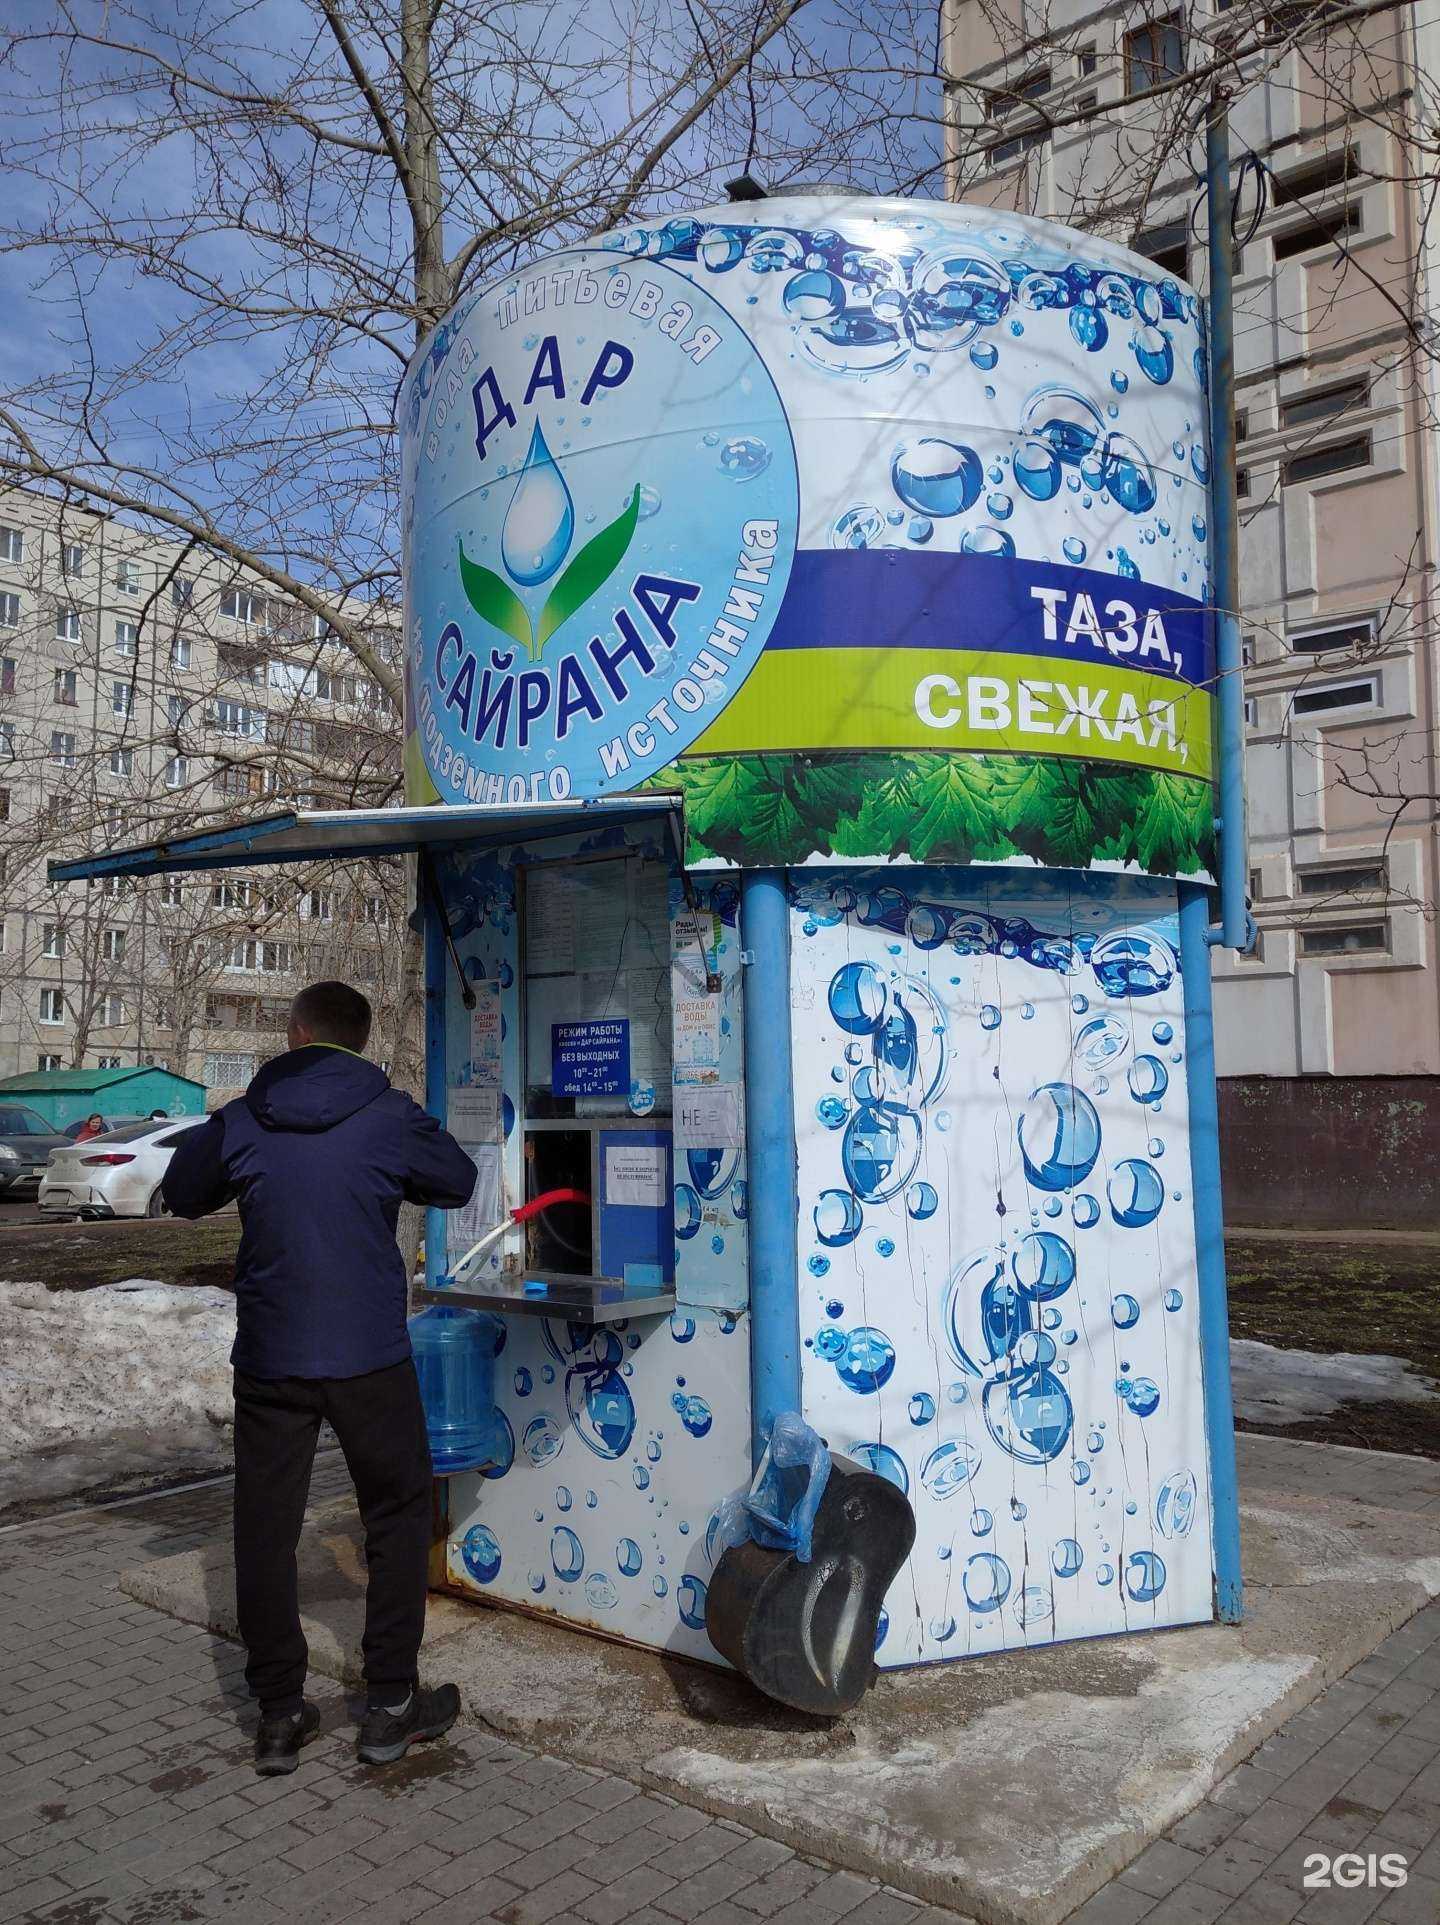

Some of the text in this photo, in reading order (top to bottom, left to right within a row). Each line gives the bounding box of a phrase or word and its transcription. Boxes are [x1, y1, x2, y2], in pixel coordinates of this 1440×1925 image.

[426, 268, 726, 465] вода питьевая
[472, 334, 635, 462] ДАР
[419, 683, 572, 804] подземного
[598, 518, 781, 779] источника
[435, 572, 703, 750] САЙРАНА
[1030, 585, 1183, 675] ТАЗА,
[913, 673, 1189, 765] СВЕЖАЯ,
[558, 1025, 623, 1038] РЕЖИМ РАБОТЫ
[676, 1001, 715, 1013] ДОСТАВКА
[684, 1012, 707, 1022] ВОДЫ
[561, 1050, 620, 1062] БЕЗ ВЫХОДНЫХ
[564, 1083, 580, 1093] обед
